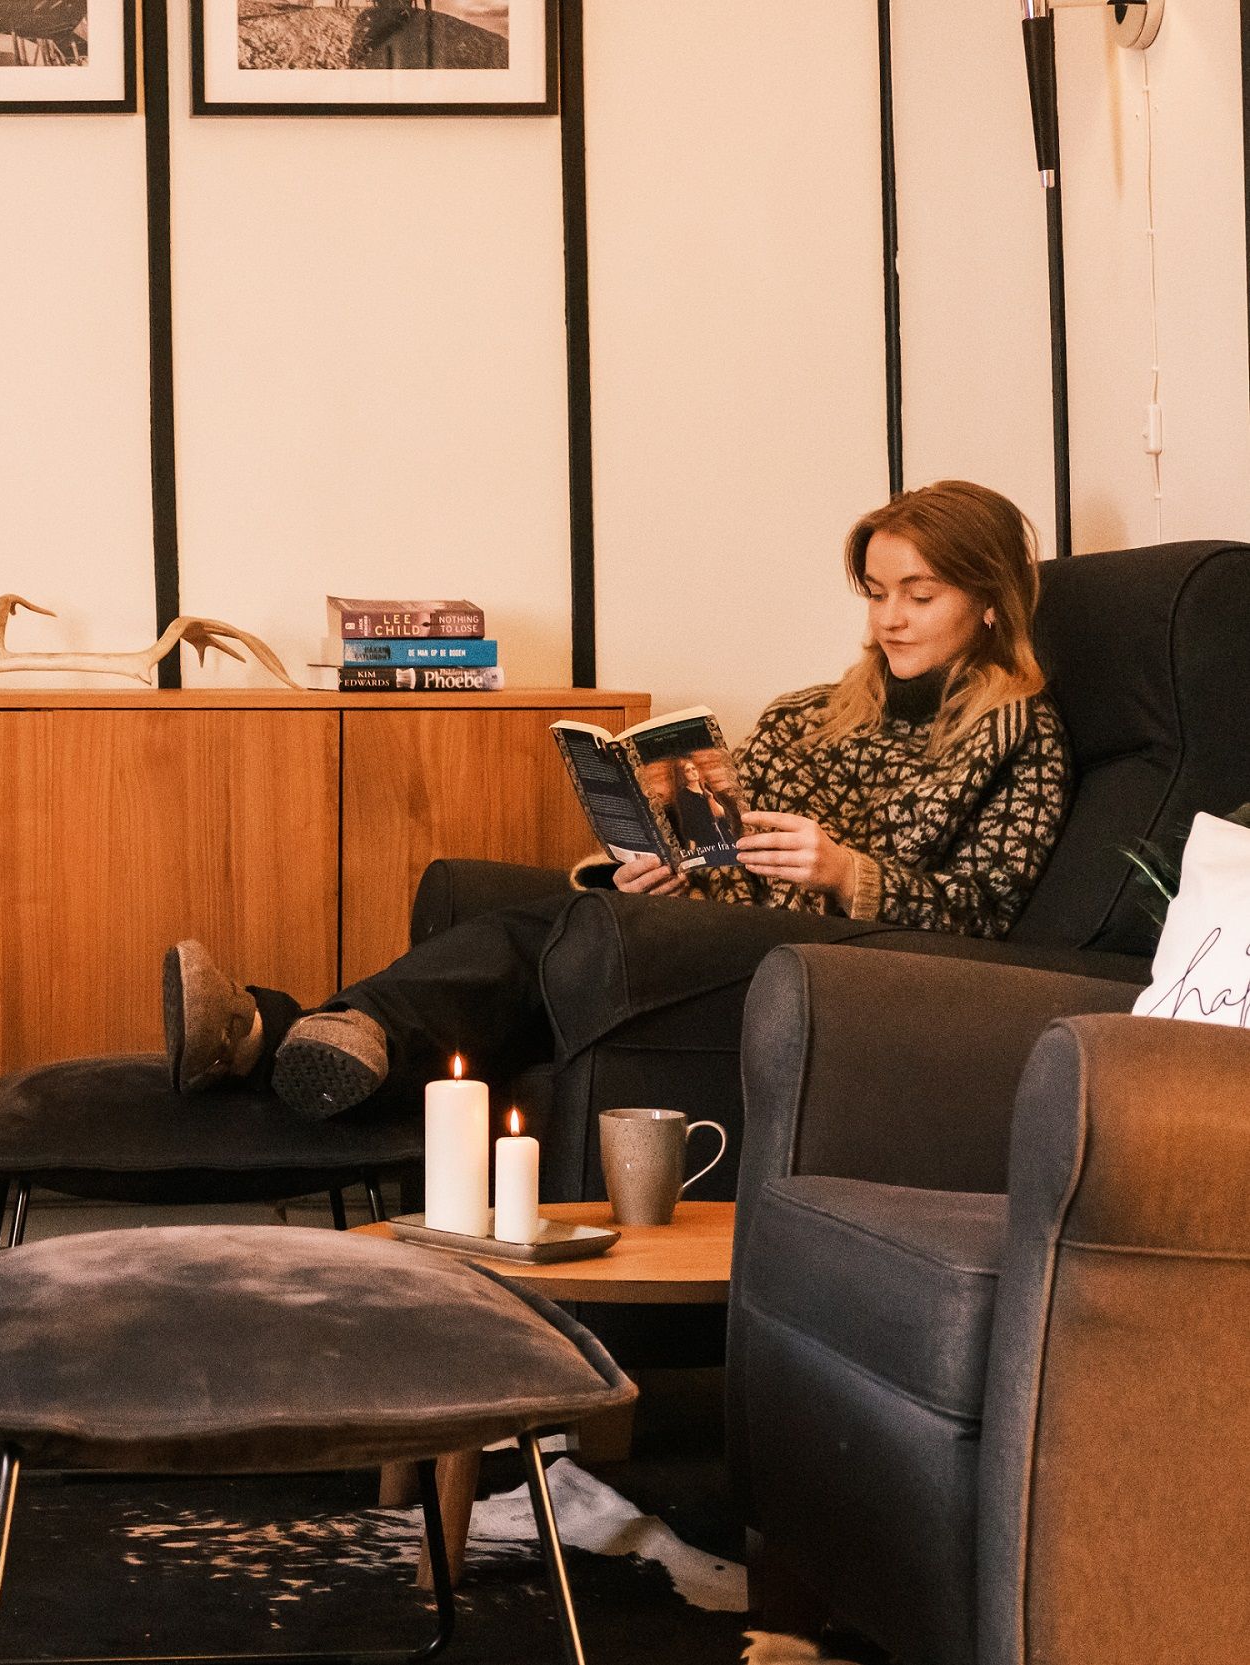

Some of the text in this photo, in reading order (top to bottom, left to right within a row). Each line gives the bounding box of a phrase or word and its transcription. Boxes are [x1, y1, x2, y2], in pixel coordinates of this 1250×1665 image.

[383, 614, 411, 625] LEE
[438, 615, 479, 625] NOTHING
[374, 625, 421, 636] CHILD
[455, 625, 478, 633] LOSE
[344, 679, 390, 687] EDWARDS
[424, 670, 483, 688] Phoebe
[679, 849, 694, 858] En
[696, 844, 716, 856] gave
